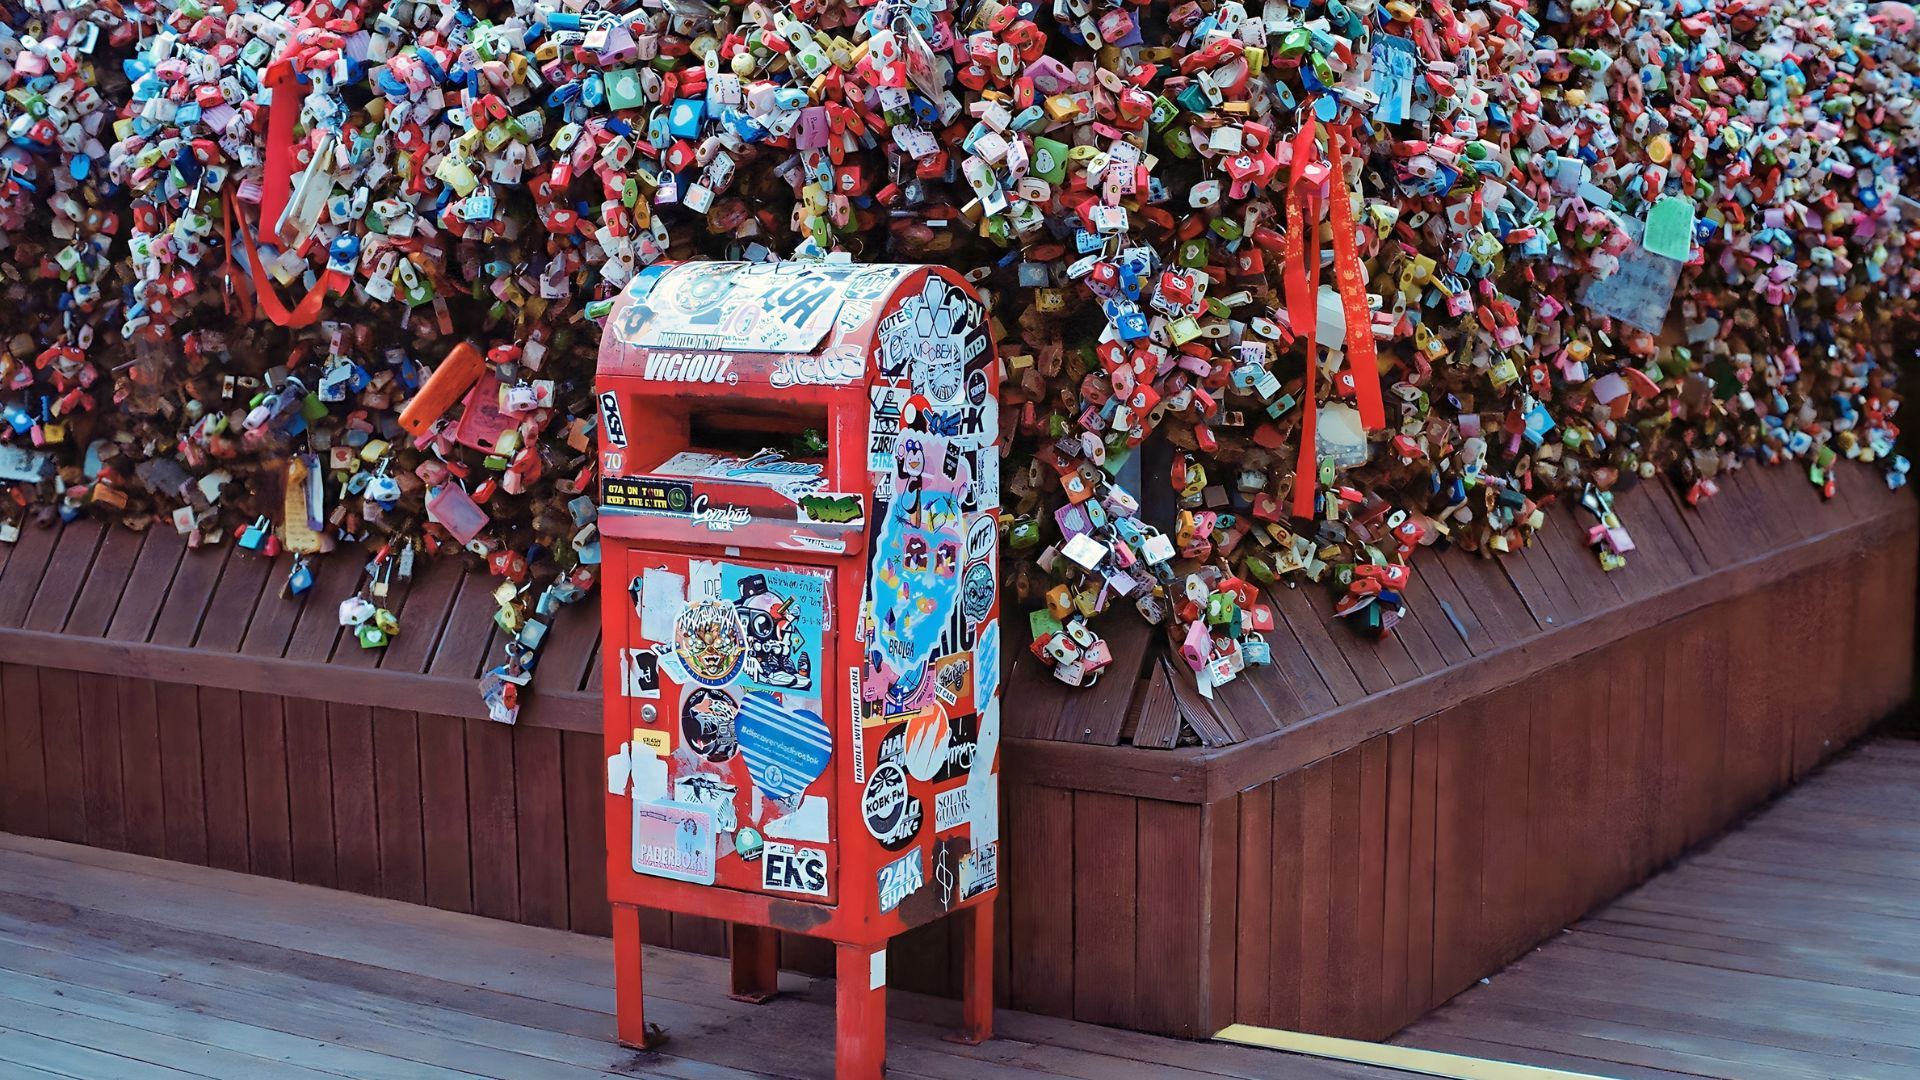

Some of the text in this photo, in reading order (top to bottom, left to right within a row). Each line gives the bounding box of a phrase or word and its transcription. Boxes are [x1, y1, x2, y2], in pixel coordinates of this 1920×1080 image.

[604, 451, 623, 471] 70
[606, 495, 626, 505] KEEP
[628, 497, 644, 508] THE
[627, 486, 639, 496] ON
[851, 668, 863, 782] HANDLE WITHOUT CARE
[937, 788, 968, 809] SOLAR
[765, 853, 826, 891] EKS
[879, 848, 921, 896] 24K
[880, 875, 923, 912] SHAKA
